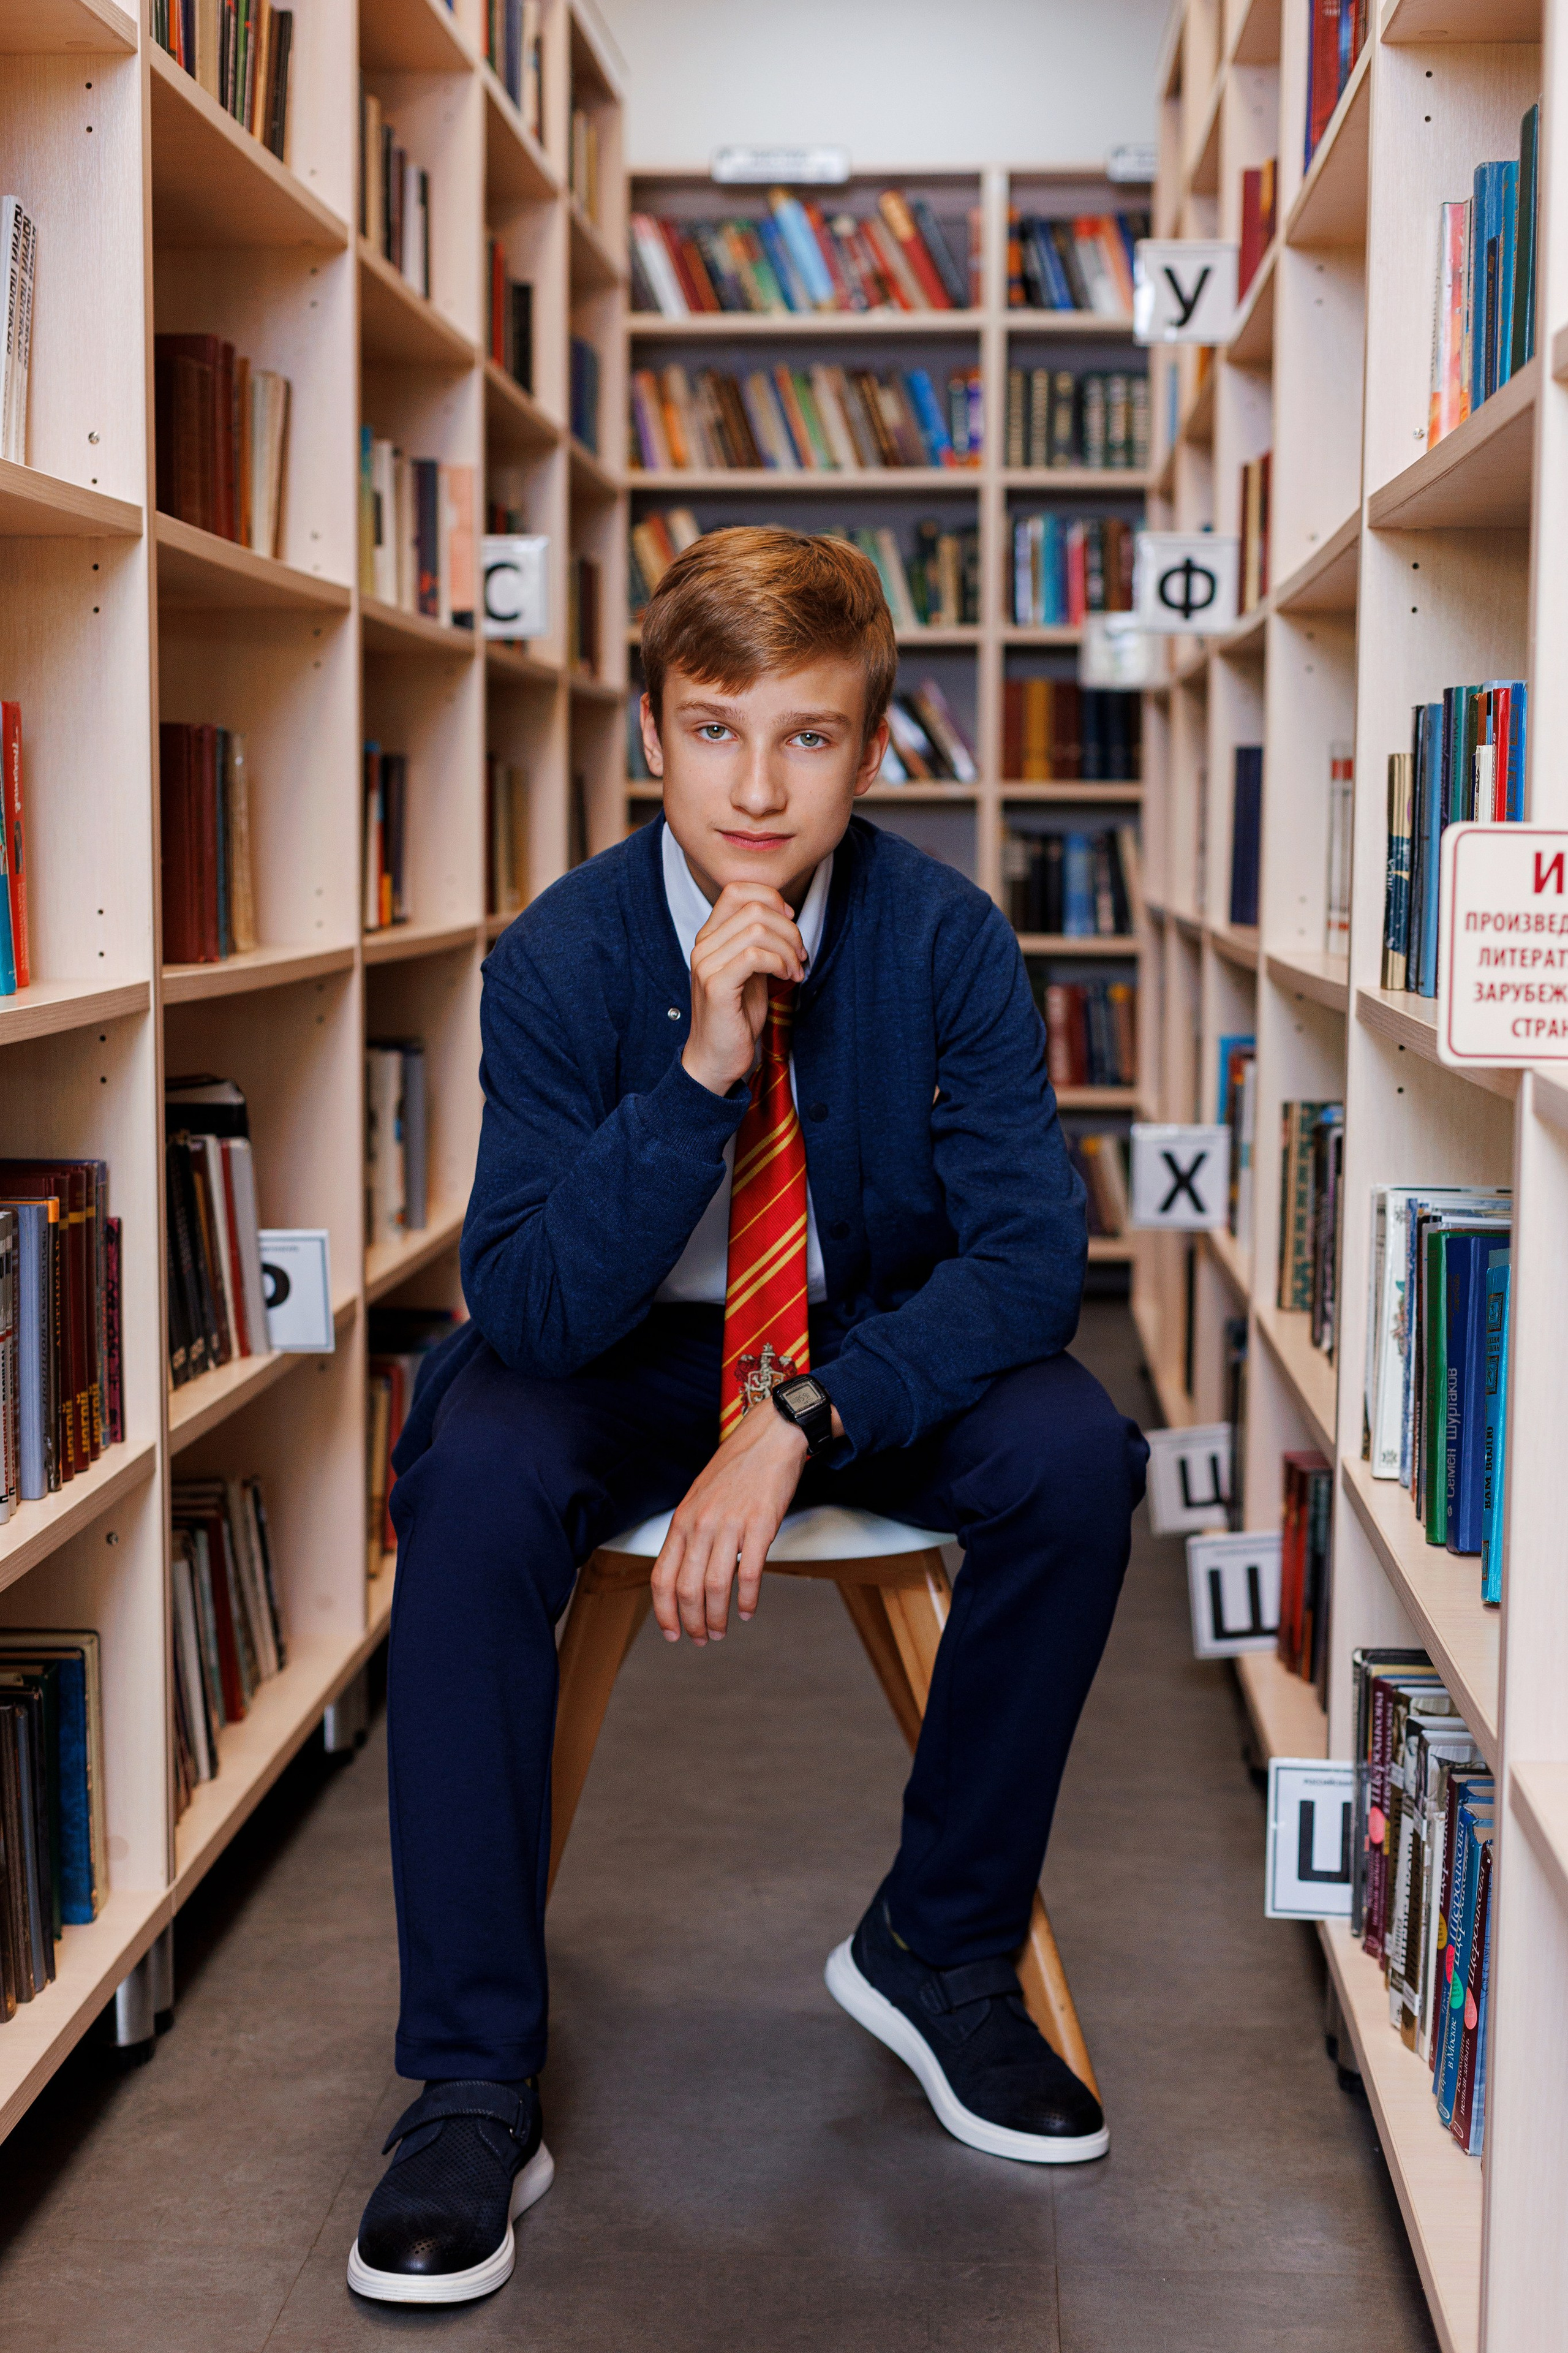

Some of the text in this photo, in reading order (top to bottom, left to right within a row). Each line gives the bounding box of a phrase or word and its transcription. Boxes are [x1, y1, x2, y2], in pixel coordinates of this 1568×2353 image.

[7, 204, 23, 356] ЮРИЙ ПОЛЯКОВ
[18, 215, 31, 363] ЮРИЙ ПОЛЯКОВ
[1164, 266, 1211, 327] У
[484, 562, 521, 622] С
[1159, 557, 1216, 621] Ф
[1159, 1151, 1208, 1214] Х
[1446, 1368, 1461, 1440] Шуртаков
[1485, 1426, 1494, 1471] ВОЛЮ
[1449, 1821, 1464, 1941] Щербакова
[1468, 1866, 1485, 1988] Щербакова
[1448, 2017, 1457, 2061] Москве
